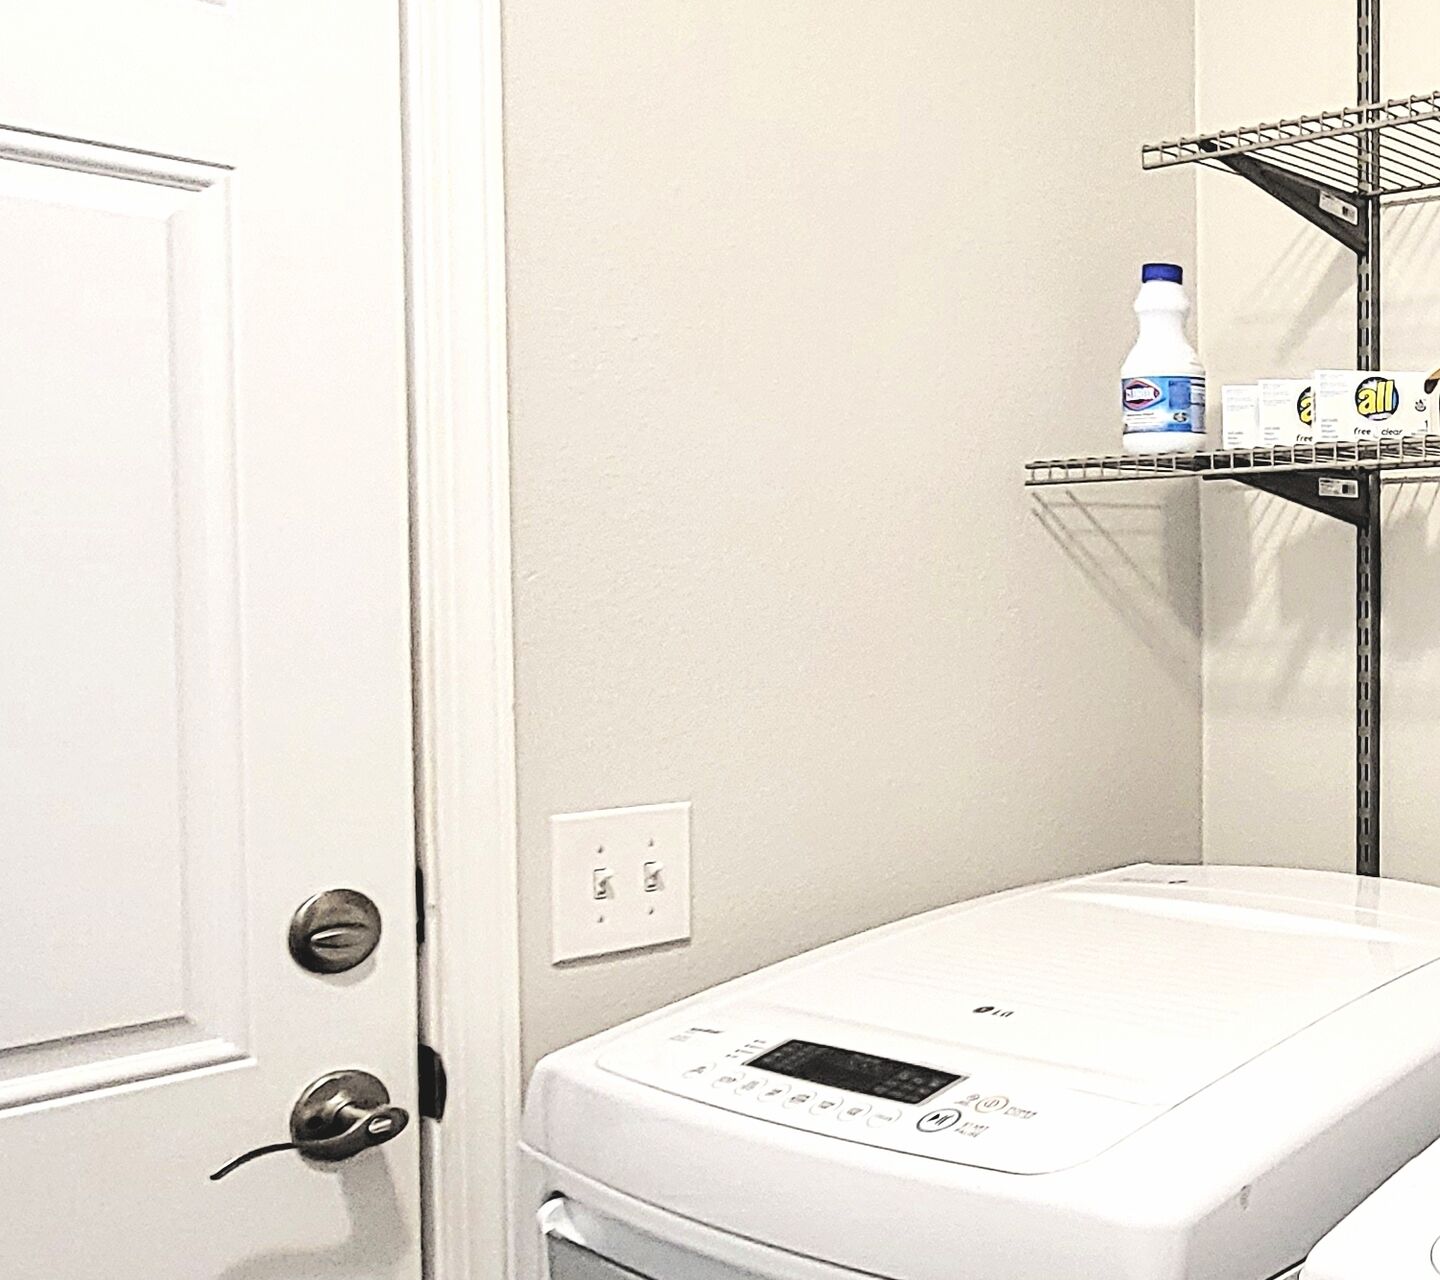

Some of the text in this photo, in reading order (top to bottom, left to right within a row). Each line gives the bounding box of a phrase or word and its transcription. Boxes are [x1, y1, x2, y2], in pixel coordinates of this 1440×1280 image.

[1358, 379, 1395, 416] all
[1354, 427, 1403, 436] free clear
